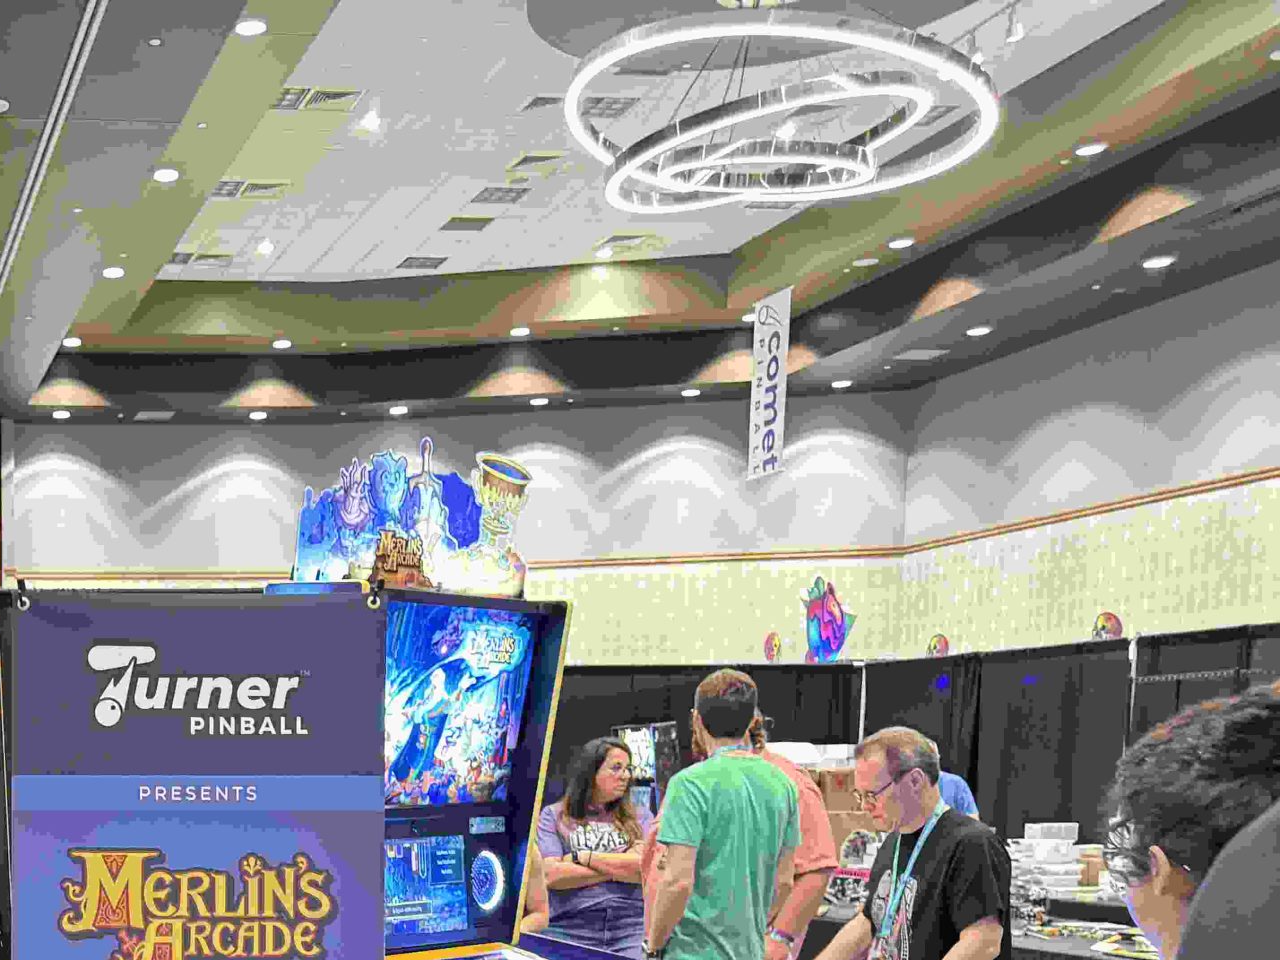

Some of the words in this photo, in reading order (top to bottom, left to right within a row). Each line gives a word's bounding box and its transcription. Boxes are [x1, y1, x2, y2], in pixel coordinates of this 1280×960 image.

[752, 338, 765, 475] PINBALL
[762, 331, 781, 473] comet
[190, 716, 308, 735] PINBALL
[139, 785, 257, 801] PRESENTS
[61, 848, 333, 932] MERLIN'S
